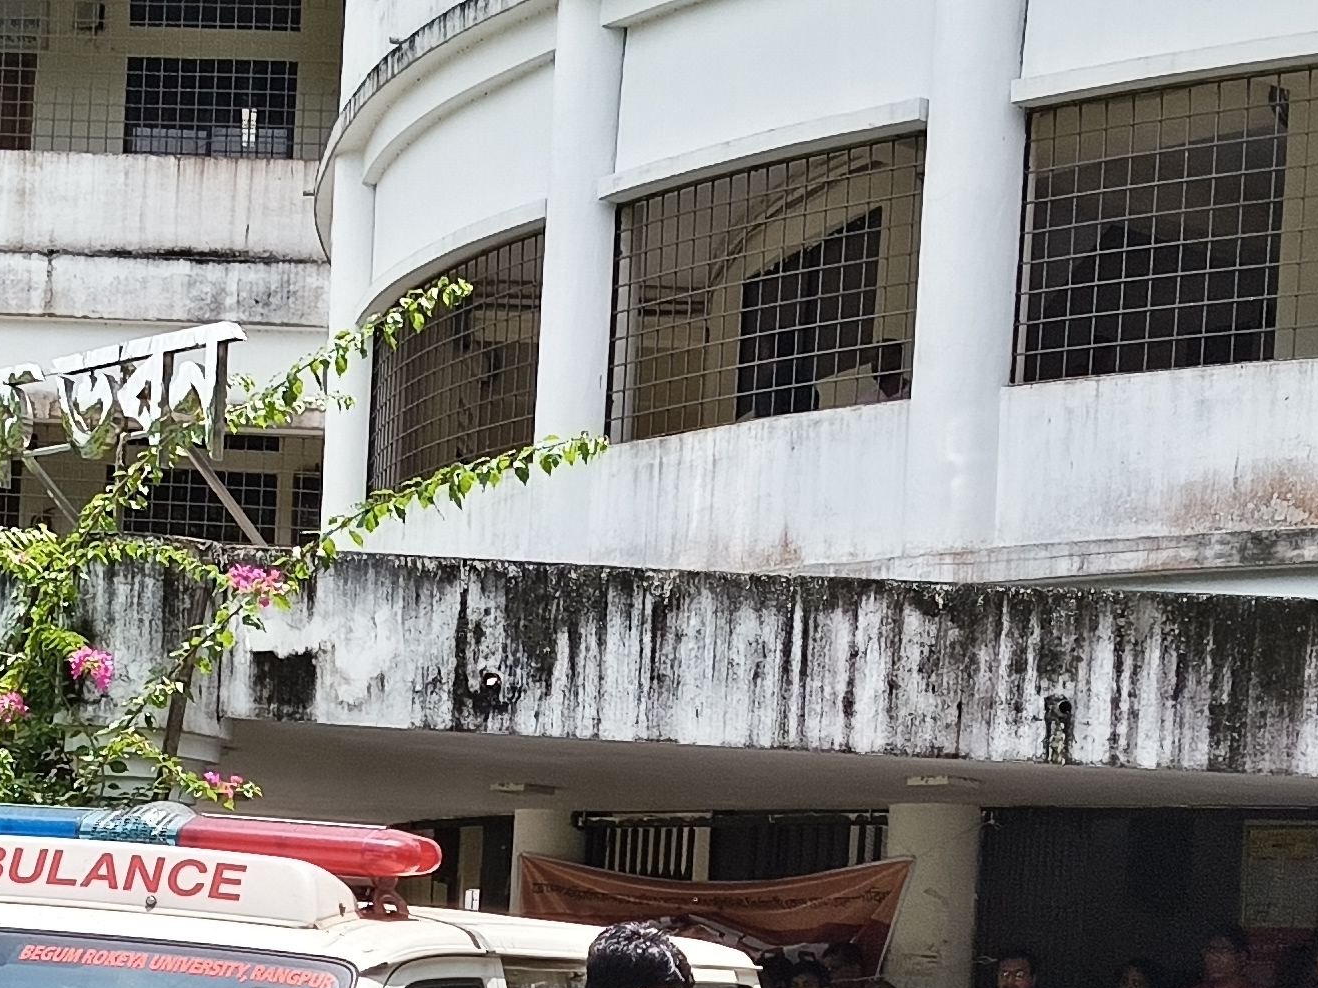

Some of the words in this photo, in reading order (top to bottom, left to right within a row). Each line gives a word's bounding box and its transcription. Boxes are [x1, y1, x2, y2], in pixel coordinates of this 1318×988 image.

[18, 944, 83, 963] BEGUM
[82, 949, 148, 968] ROKEYA
[149, 954, 251, 983] UNIVERSITY,
